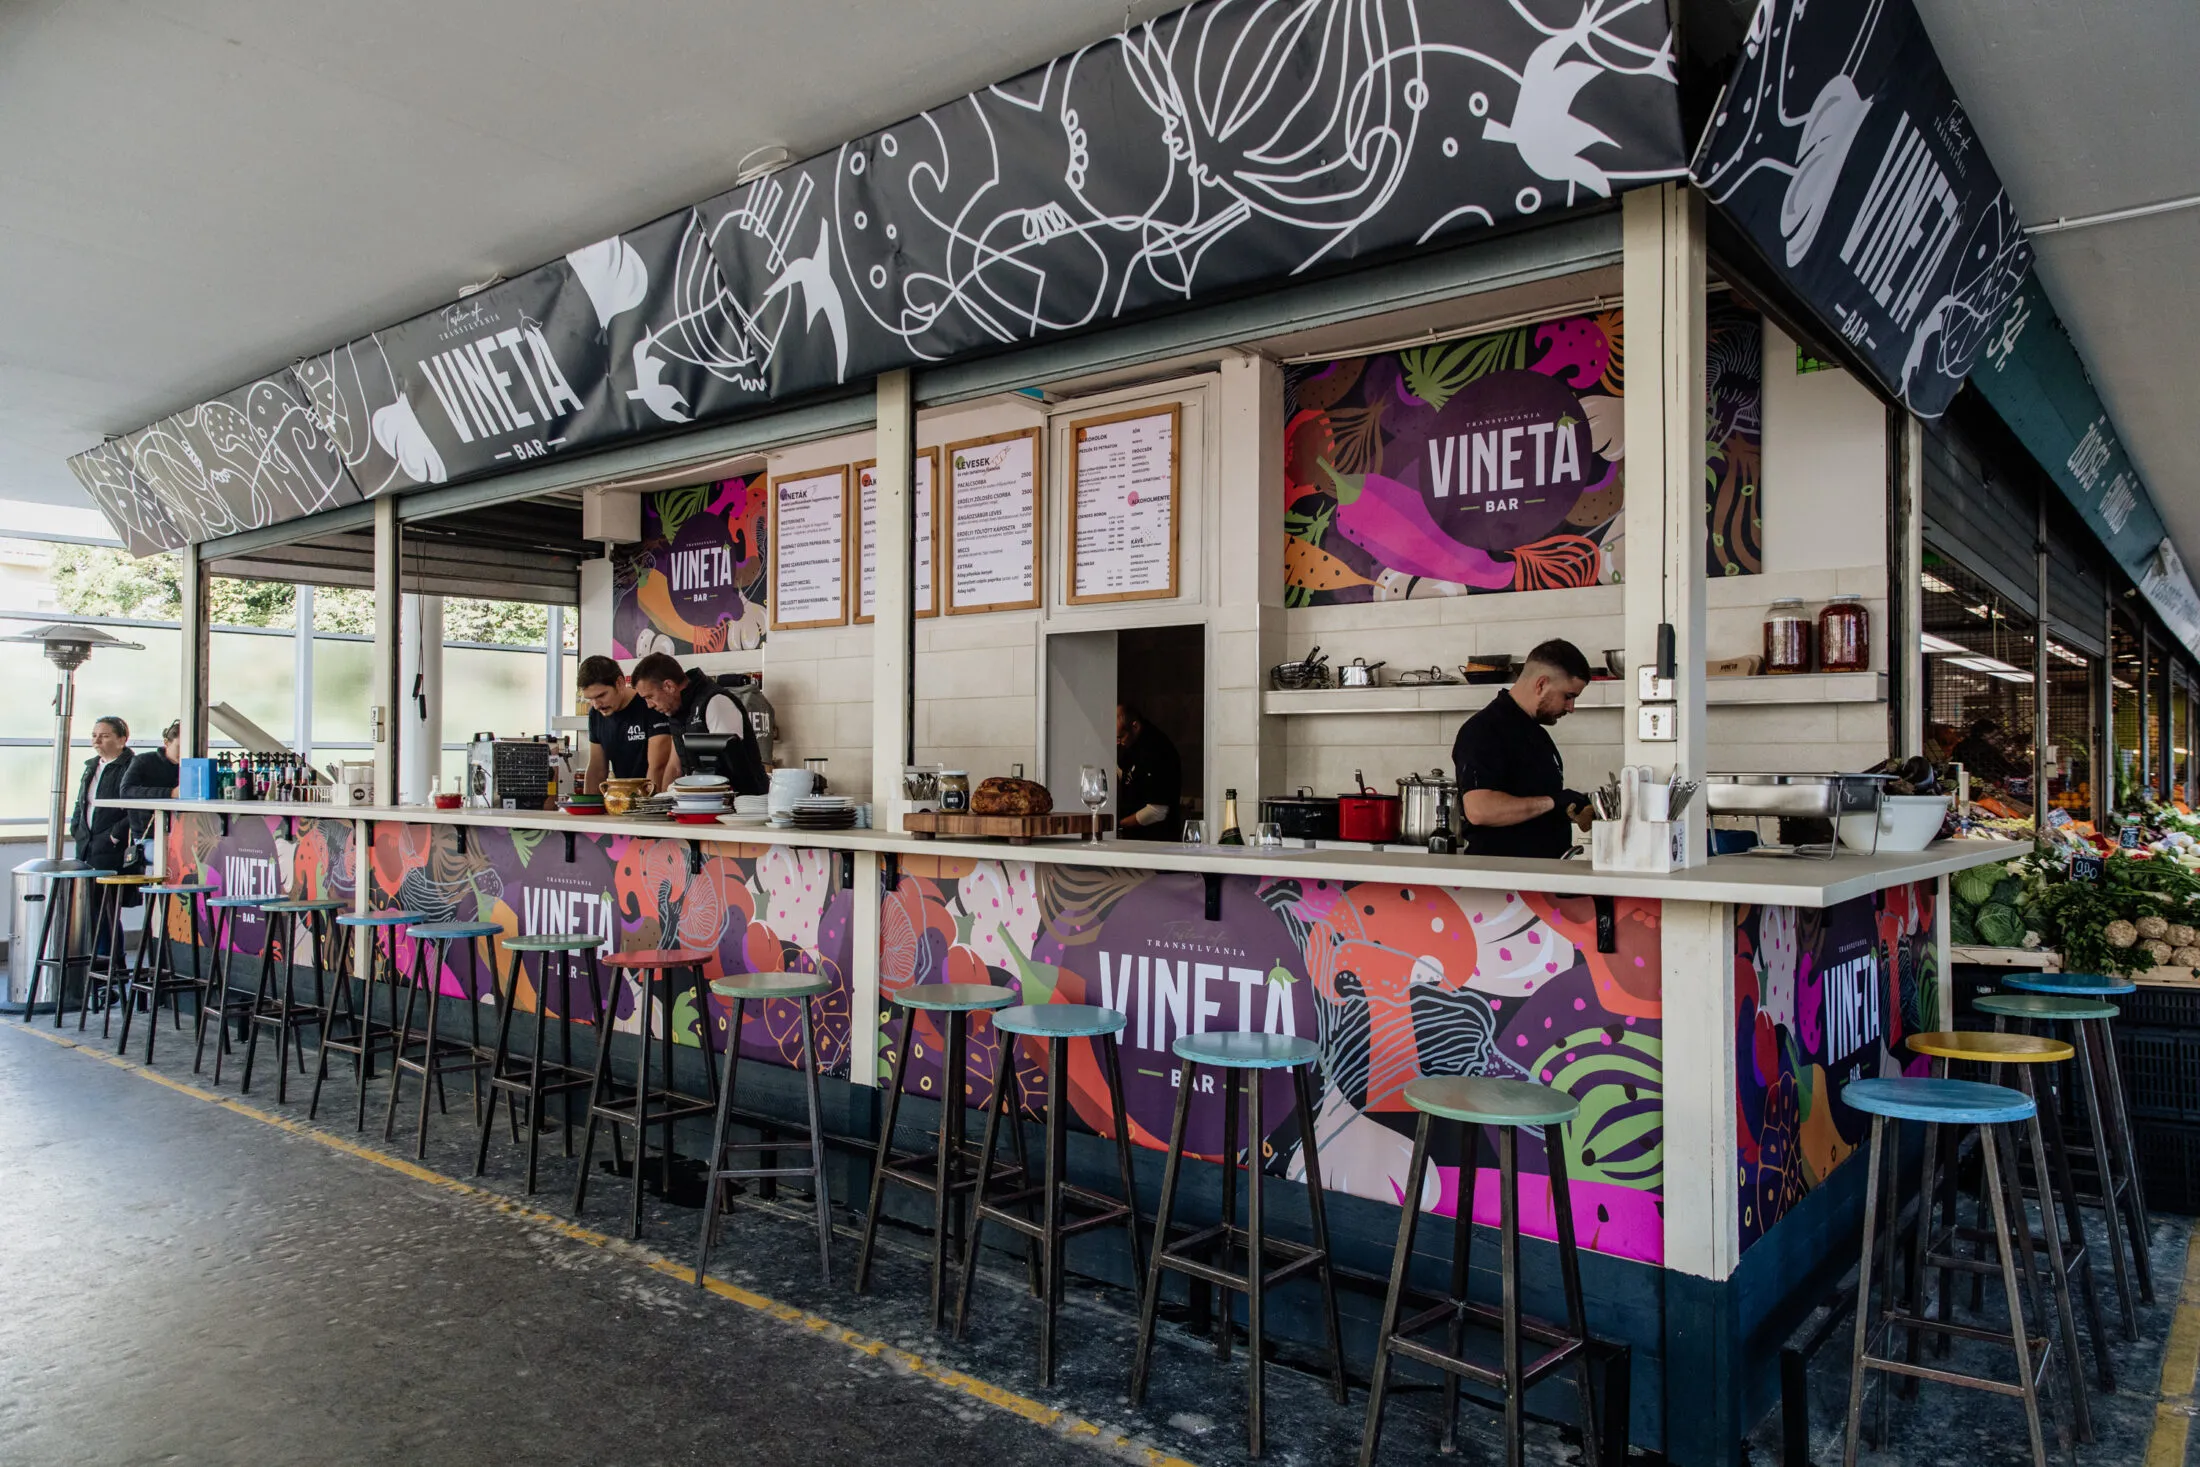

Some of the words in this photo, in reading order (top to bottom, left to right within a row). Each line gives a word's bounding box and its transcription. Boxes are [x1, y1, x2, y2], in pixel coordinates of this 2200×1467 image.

[1839, 110, 1962, 333] VINETA
[1841, 309, 1869, 346] BAR
[418, 323, 584, 443] VINETA
[1466, 412, 1541, 428] TRANSYLVANIA
[512, 438, 547, 460] BAR
[957, 457, 990, 470] LEVESEK
[1428, 421, 1580, 498] VINETA
[988, 509, 1002, 517] LEVES
[1485, 498, 1519, 513] BAR
[671, 547, 732, 591] VINETA
[693, 593, 708, 602] BAR
[225, 855, 277, 896] VINETA
[546, 876, 592, 887] TRANSYLVANIA
[242, 912, 256, 924] BAR
[523, 886, 614, 960] VINETA
[1147, 938, 1246, 957] TRANSYLVANIA
[1099, 950, 1296, 1073] VINETA
[1823, 953, 1880, 1066] VINETA
